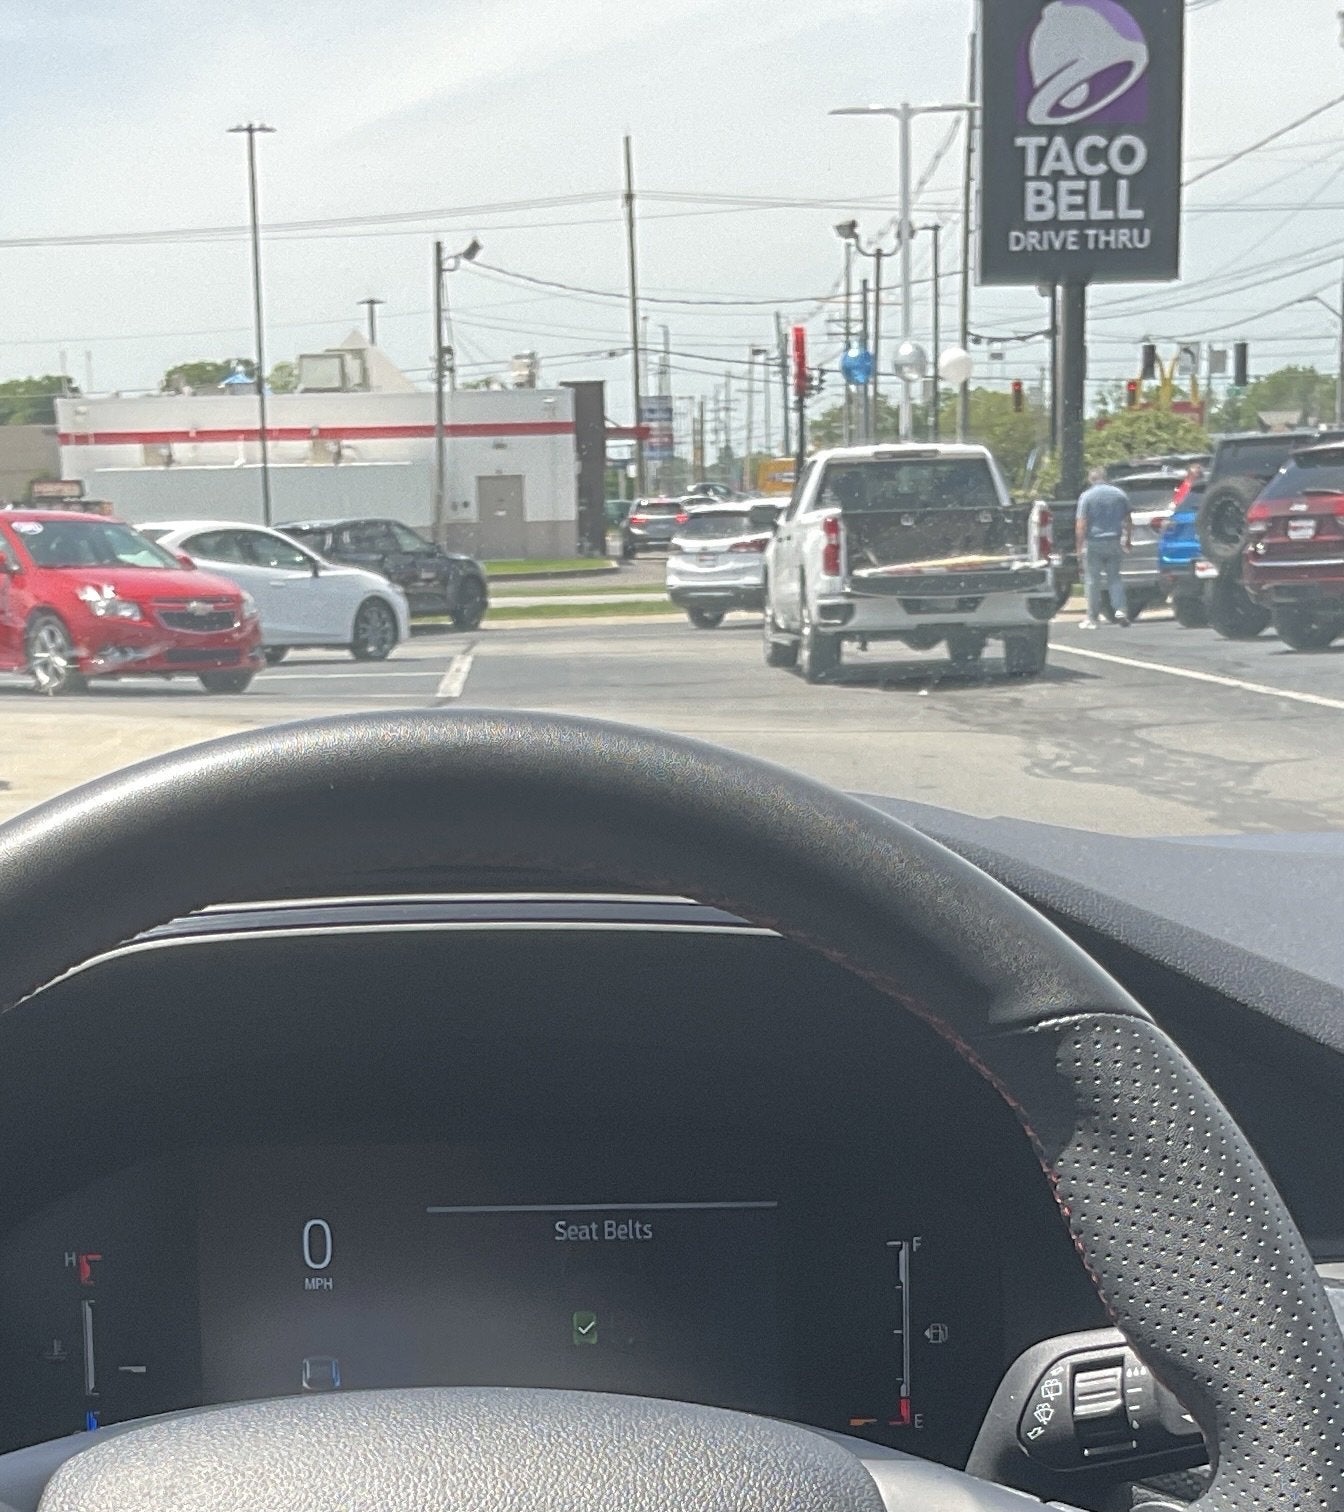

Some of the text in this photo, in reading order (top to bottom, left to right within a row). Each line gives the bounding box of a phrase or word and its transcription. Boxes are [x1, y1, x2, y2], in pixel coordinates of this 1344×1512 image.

[1014, 135, 1148, 177] TACO
[1024, 179, 1144, 221] BELL
[1009, 228, 1151, 252] DRIVE THRU
[554, 1219, 653, 1241] Seat Belts
[303, 1218, 333, 1270] 0
[912, 1236, 922, 1252] F
[65, 1252, 77, 1267] H
[305, 1278, 333, 1290] MPH
[914, 1413, 924, 1429] E
